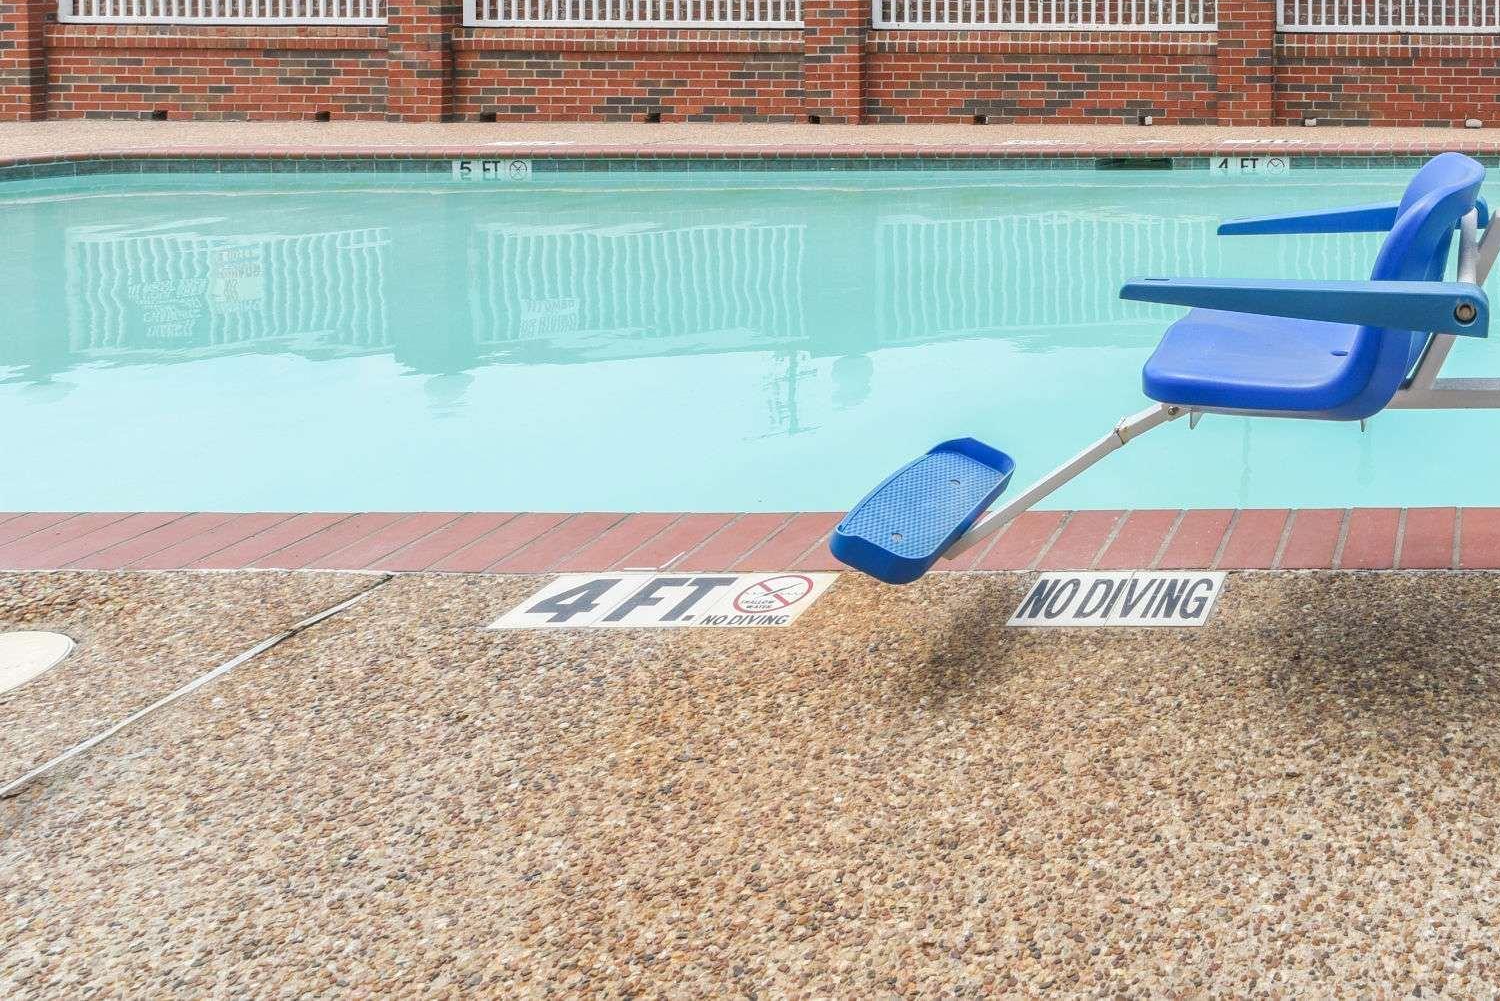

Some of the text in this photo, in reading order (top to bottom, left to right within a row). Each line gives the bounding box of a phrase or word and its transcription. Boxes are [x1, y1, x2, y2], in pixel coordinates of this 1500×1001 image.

[460, 160, 501, 173] 5 FT
[525, 578, 624, 623] 4
[1015, 578, 1214, 620] NO DIVING
[700, 614, 791, 625] NO DIVING
